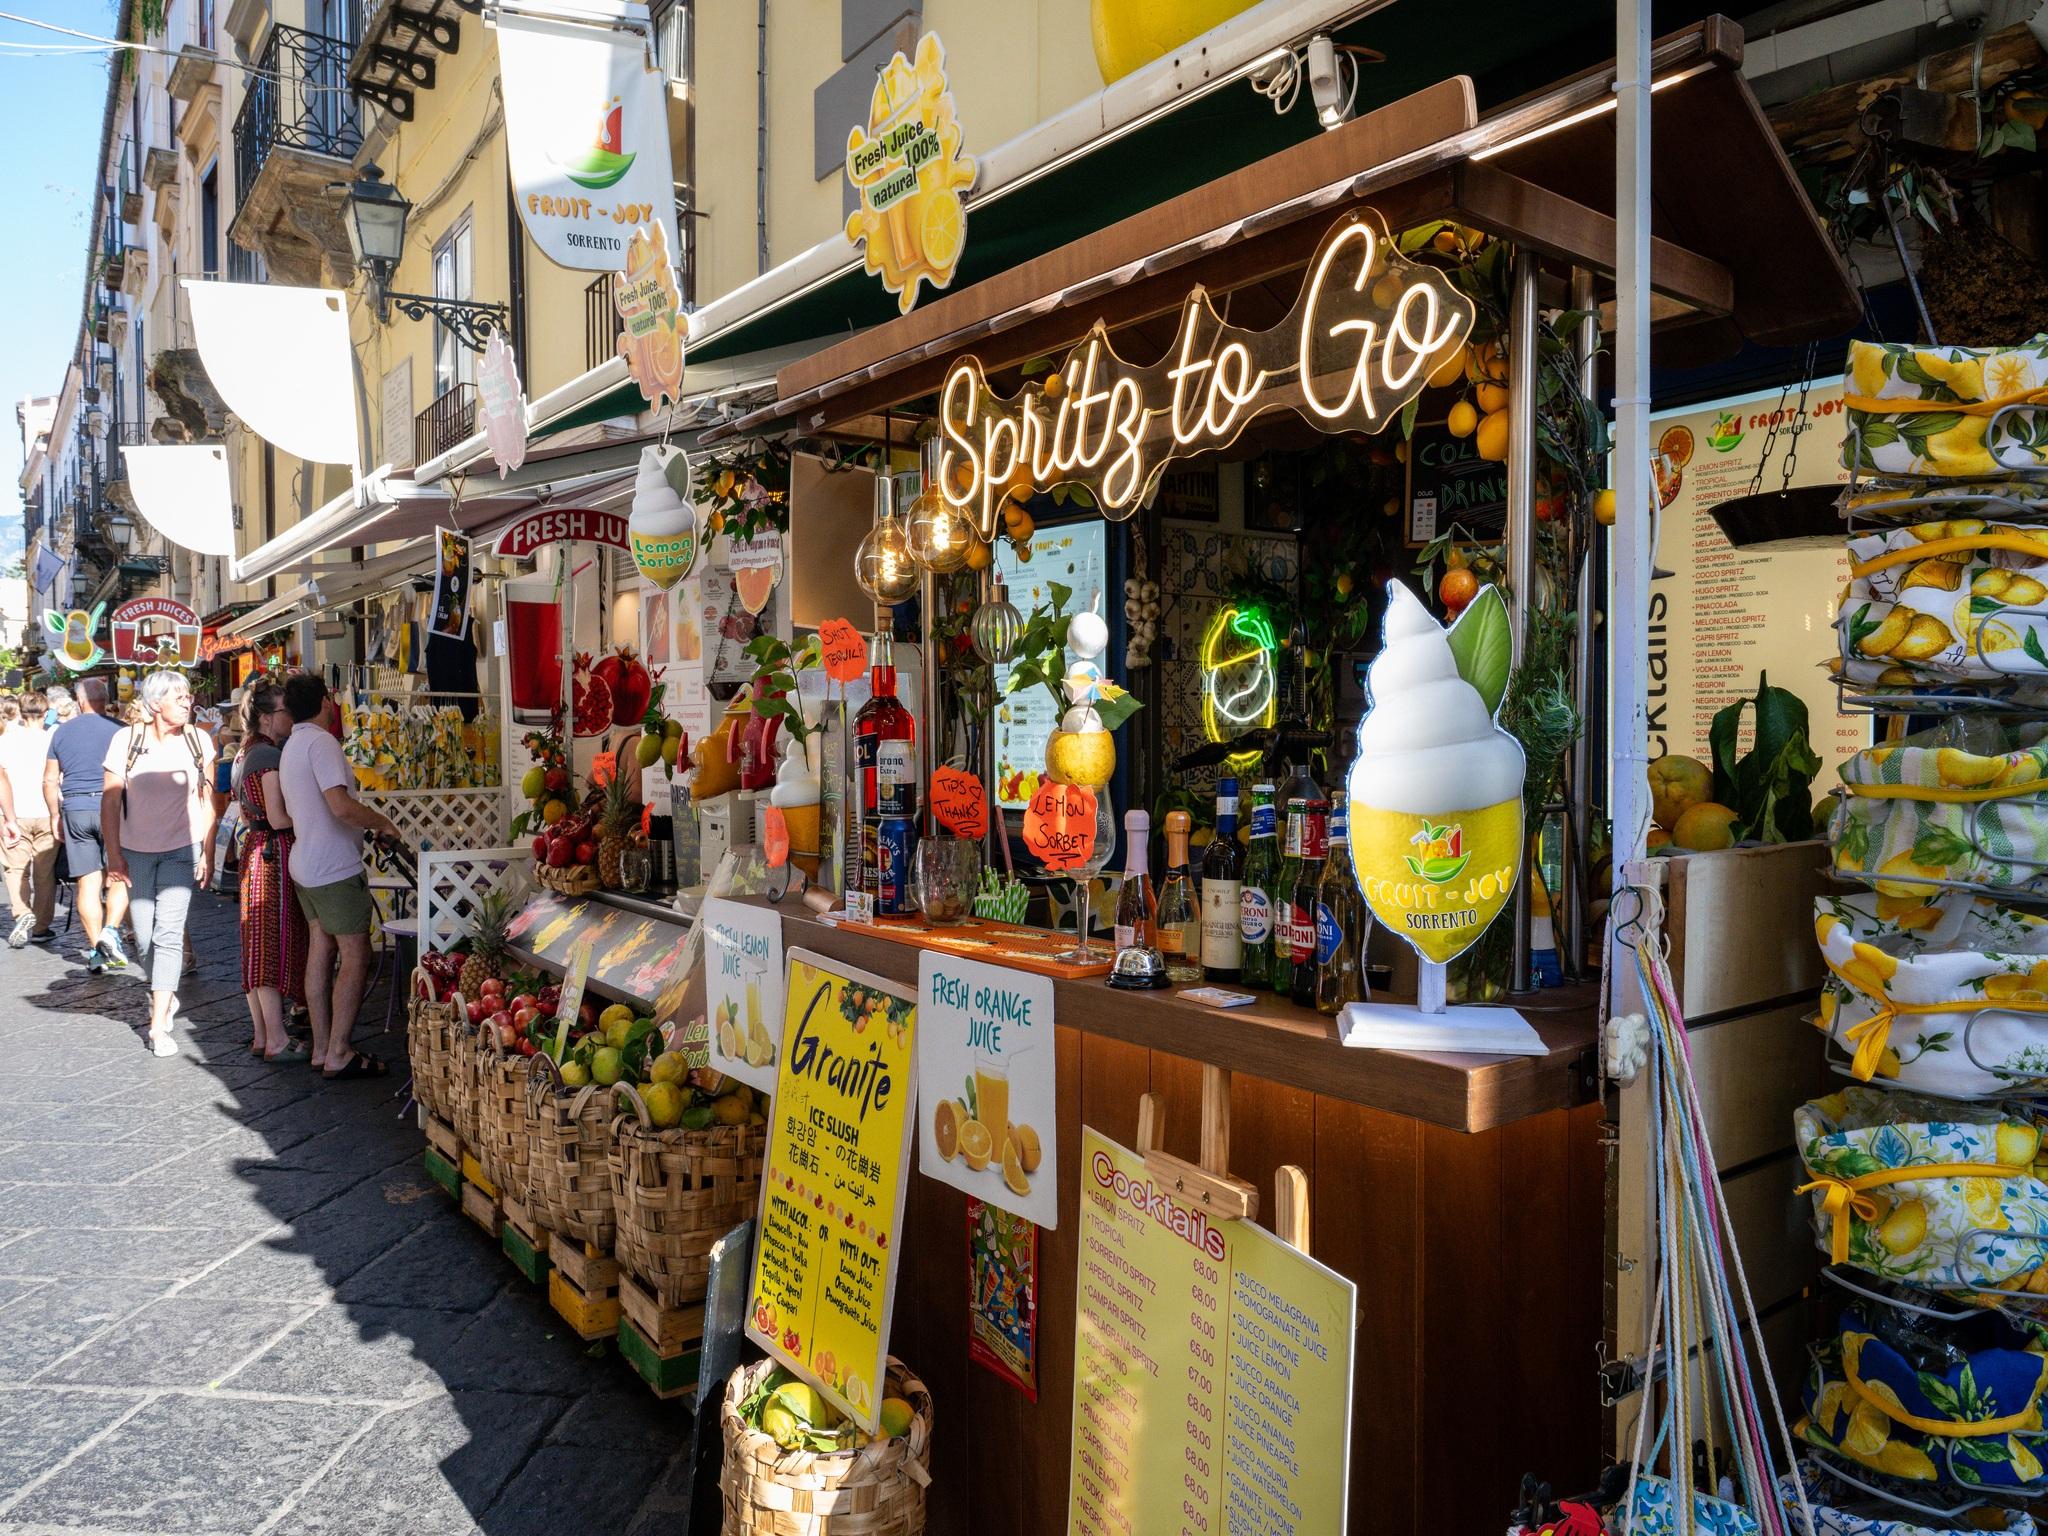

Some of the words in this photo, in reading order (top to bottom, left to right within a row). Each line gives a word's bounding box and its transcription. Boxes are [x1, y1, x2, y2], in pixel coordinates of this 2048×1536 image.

[854, 140, 887, 175] Fresh
[891, 121, 924, 153] Juice
[905, 132, 940, 168] 100%
[873, 166, 917, 207] natural
[527, 193, 592, 220] FRUIT
[612, 202, 653, 225] JOY
[566, 232, 621, 251] SORRENTO
[619, 288, 639, 307] Fresh
[639, 280, 658, 298] Juice
[648, 291, 668, 312] 100%
[631, 312, 657, 333] natural
[939, 338, 1150, 533] Spritz
[1167, 301, 1268, 445] to
[1299, 221, 1462, 420] Go
[1813, 399, 1845, 418] JOY
[1419, 442, 1480, 466] COL
[513, 512, 586, 553] FRESH
[635, 537, 691, 554] Lemon
[636, 550, 693, 568] Sorbet
[1721, 567, 1744, 577] SPRITZ
[1715, 584, 1739, 594] SPRITZ
[122, 600, 154, 622] FRESH
[156, 601, 192, 623] JUICES
[1695, 616, 1741, 627] MELONCELLO
[1742, 614, 1766, 623] SPRITZ
[823, 627, 850, 646] SHOT
[1695, 633, 1715, 642] CAPRI
[1715, 632, 1739, 641] SPRITZ
[826, 643, 865, 668] TEQUILA
[1695, 649, 1707, 658] GIN
[1707, 648, 1732, 658] LEMON
[1695, 665, 1720, 673] VODKA
[1720, 664, 1744, 673] LEMON
[1695, 681, 1726, 689] NEGRONI
[1695, 697, 1725, 705] NEGRONI
[934, 800, 980, 820] THANKS
[1033, 795, 1085, 818] LEMON
[1034, 823, 1088, 852] SORBET
[1365, 875, 1440, 909] FRUIT
[1464, 866, 1512, 904] JOY
[1406, 909, 1477, 930] SORRENTO
[741, 931, 769, 961] LEMON
[721, 952, 741, 980] JUICE
[932, 972, 969, 1011] FRESH
[975, 987, 1032, 1027] ORANGE
[790, 980, 891, 1124] Granite
[966, 1017, 1002, 1055] JUICE
[786, 1115, 818, 1148] 화강암
[808, 1105, 825, 1129] ICE
[826, 1114, 859, 1147] SLUSH
[771, 1195, 788, 1217] WITH
[1090, 1190, 1117, 1217] LEMON
[1118, 1207, 1145, 1237] SPRITZ
[1091, 1151, 1226, 1262] Cocktails
[818, 1224, 829, 1242] OR
[1090, 1213, 1126, 1249] TROPICAL
[763, 1228, 786, 1253] Prosecco
[791, 1245, 808, 1269] Vodka
[839, 1237, 859, 1262] WITH
[762, 1262, 781, 1287] Tequila
[785, 1281, 803, 1302] Aperol
[856, 1268, 873, 1292] Juice
[1089, 1236, 1129, 1275] SORRENTO
[1129, 1265, 1156, 1296] SPRITZ
[1193, 1258, 1218, 1285] €8,00
[854, 1287, 871, 1310] Juice
[1088, 1261, 1116, 1292] APEROL
[1117, 1281, 1144, 1312] SPRITZ
[1191, 1284, 1217, 1312] €8,00
[1087, 1284, 1120, 1320] CAMPARI
[1120, 1309, 1146, 1341] SPRITZ
[1239, 1272, 1267, 1300] SUCCO
[1268, 1292, 1320, 1336] MELAGRANA
[860, 1308, 877, 1334] Juice
[1190, 1312, 1216, 1340] €6,00
[1238, 1290, 1301, 1343] POMOGRANATE
[1302, 1335, 1328, 1362] JUICE
[1086, 1307, 1131, 1355] MELAGRANA
[1131, 1345, 1159, 1378] SPRITZ
[1086, 1331, 1128, 1376] SGROPPINO
[1189, 1339, 1214, 1368] €5,00
[1237, 1314, 1266, 1342] SUCCO
[1266, 1333, 1300, 1368] LIMONE
[1236, 1334, 1260, 1358] JUICE
[1261, 1350, 1291, 1381] LEMON
[1085, 1355, 1112, 1387] COCCO
[1112, 1379, 1138, 1412] SPRITZ
[1188, 1366, 1212, 1394] €7,00
[1235, 1354, 1263, 1384] SUCCO
[1264, 1378, 1301, 1414] ARANCIA
[1084, 1379, 1105, 1407] HUGO
[1105, 1398, 1131, 1432] SPRITZ
[1187, 1393, 1212, 1423] €8,00
[1234, 1375, 1257, 1400] JUICE
[1258, 1391, 1293, 1428] ORANGE
[1083, 1402, 1129, 1456] PINACOLADA
[1186, 1419, 1211, 1450] €8,00
[1233, 1395, 1261, 1426] SUCCO
[1261, 1419, 1295, 1454] ANANAS
[1082, 1426, 1104, 1455] CAPRI
[1103, 1450, 1129, 1482] SPRITZ
[1185, 1446, 1210, 1477] €8,00
[1232, 1415, 1255, 1441] JUICE
[1256, 1431, 1300, 1477] PINEAPPLE
[1081, 1449, 1095, 1471] GIN
[1094, 1465, 1120, 1497] LEMON
[1231, 1435, 1256, 1463] SUCCO
[1256, 1458, 1289, 1492] ANGURIA
[1184, 1473, 1208, 1504] €8,00
[1231, 1453, 1251, 1476] JUICE
[1251, 1467, 1302, 1520] WATERMELON
[1081, 1472, 1105, 1505] VODKA
[1105, 1501, 1132, 1536] LEMON
[1183, 1500, 1207, 1532] €8,00
[1229, 1490, 1262, 1525] ARANCIA
[1230, 1473, 1263, 1510] GRANITE
[1263, 1504, 1295, 1535] LIMONE
